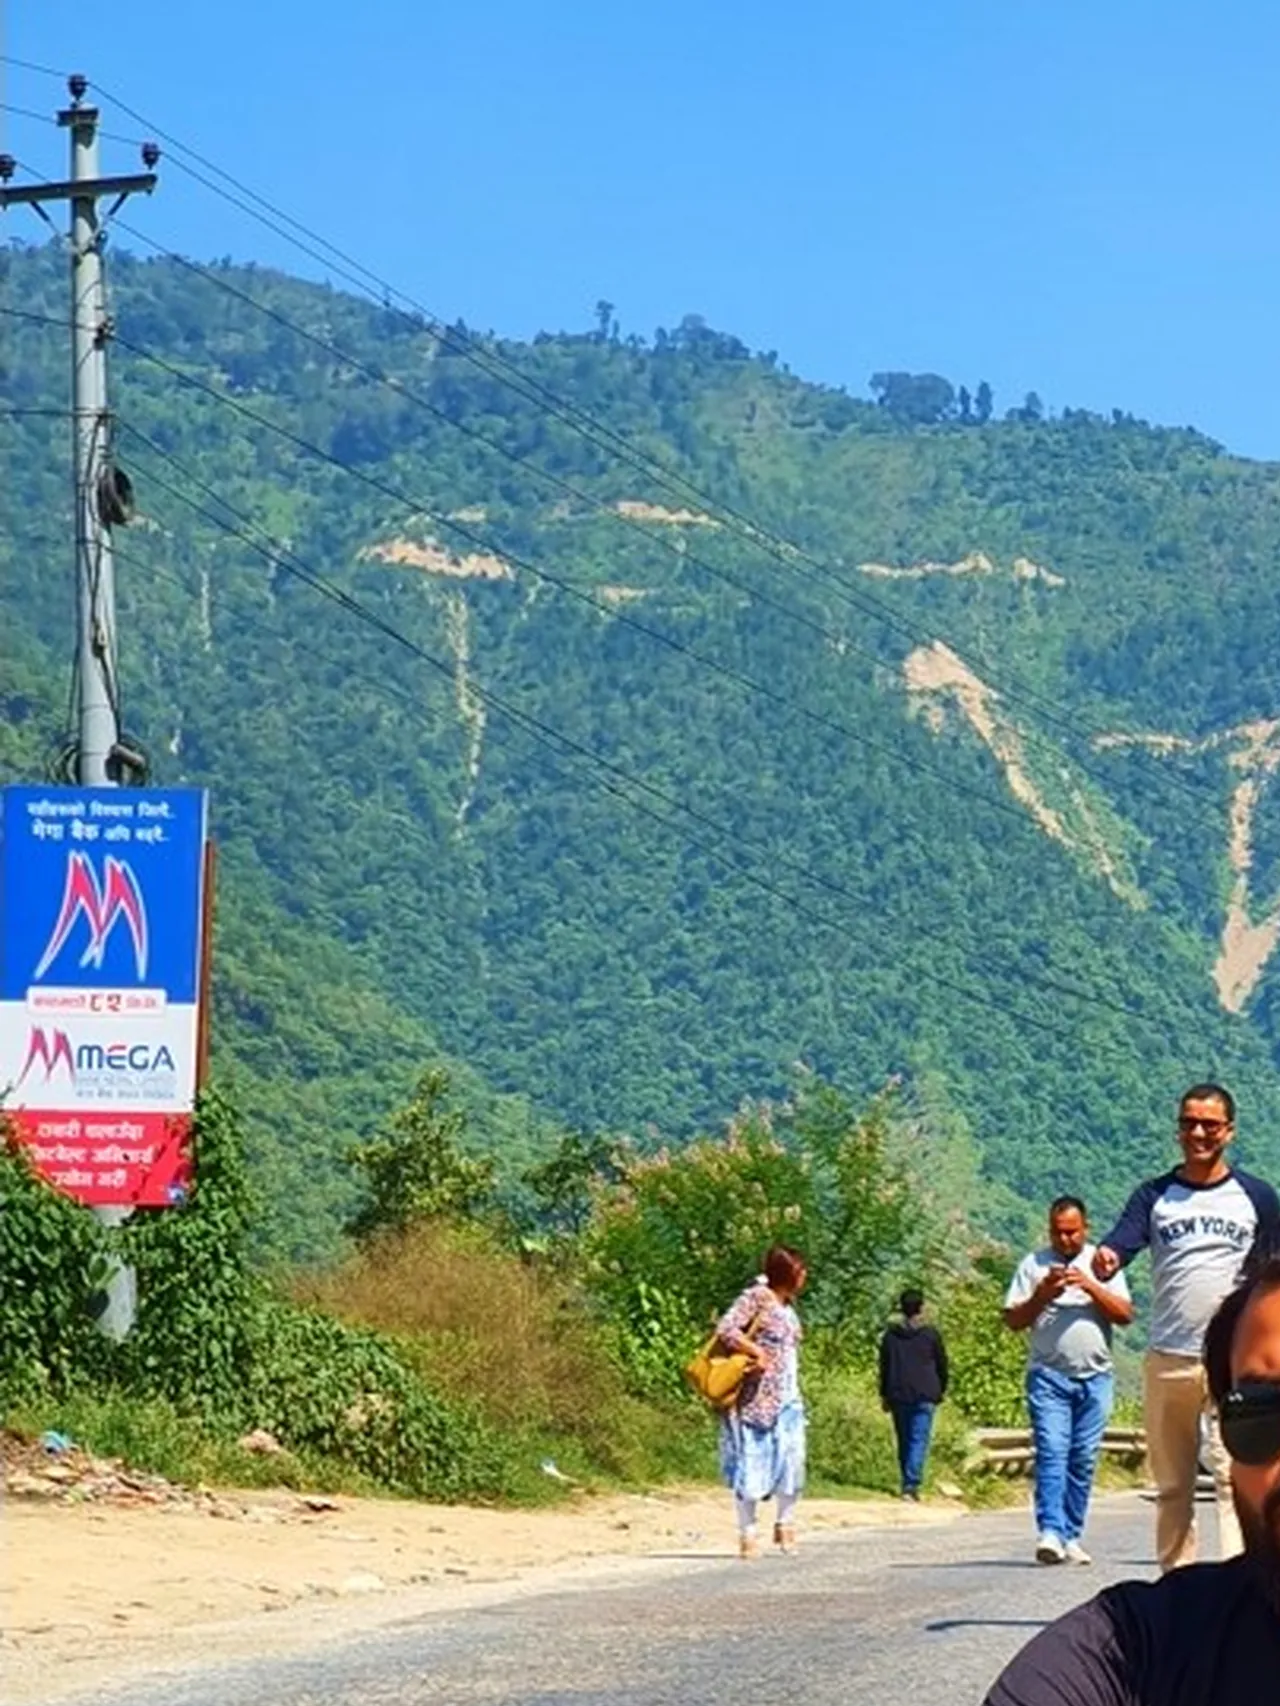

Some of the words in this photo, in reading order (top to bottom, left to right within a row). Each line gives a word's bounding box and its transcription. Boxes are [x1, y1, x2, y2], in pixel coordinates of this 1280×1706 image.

[77, 1044, 175, 1072] MEGA
[1160, 1216, 1196, 1245] NEW
[1200, 1216, 1249, 1244] YORK
